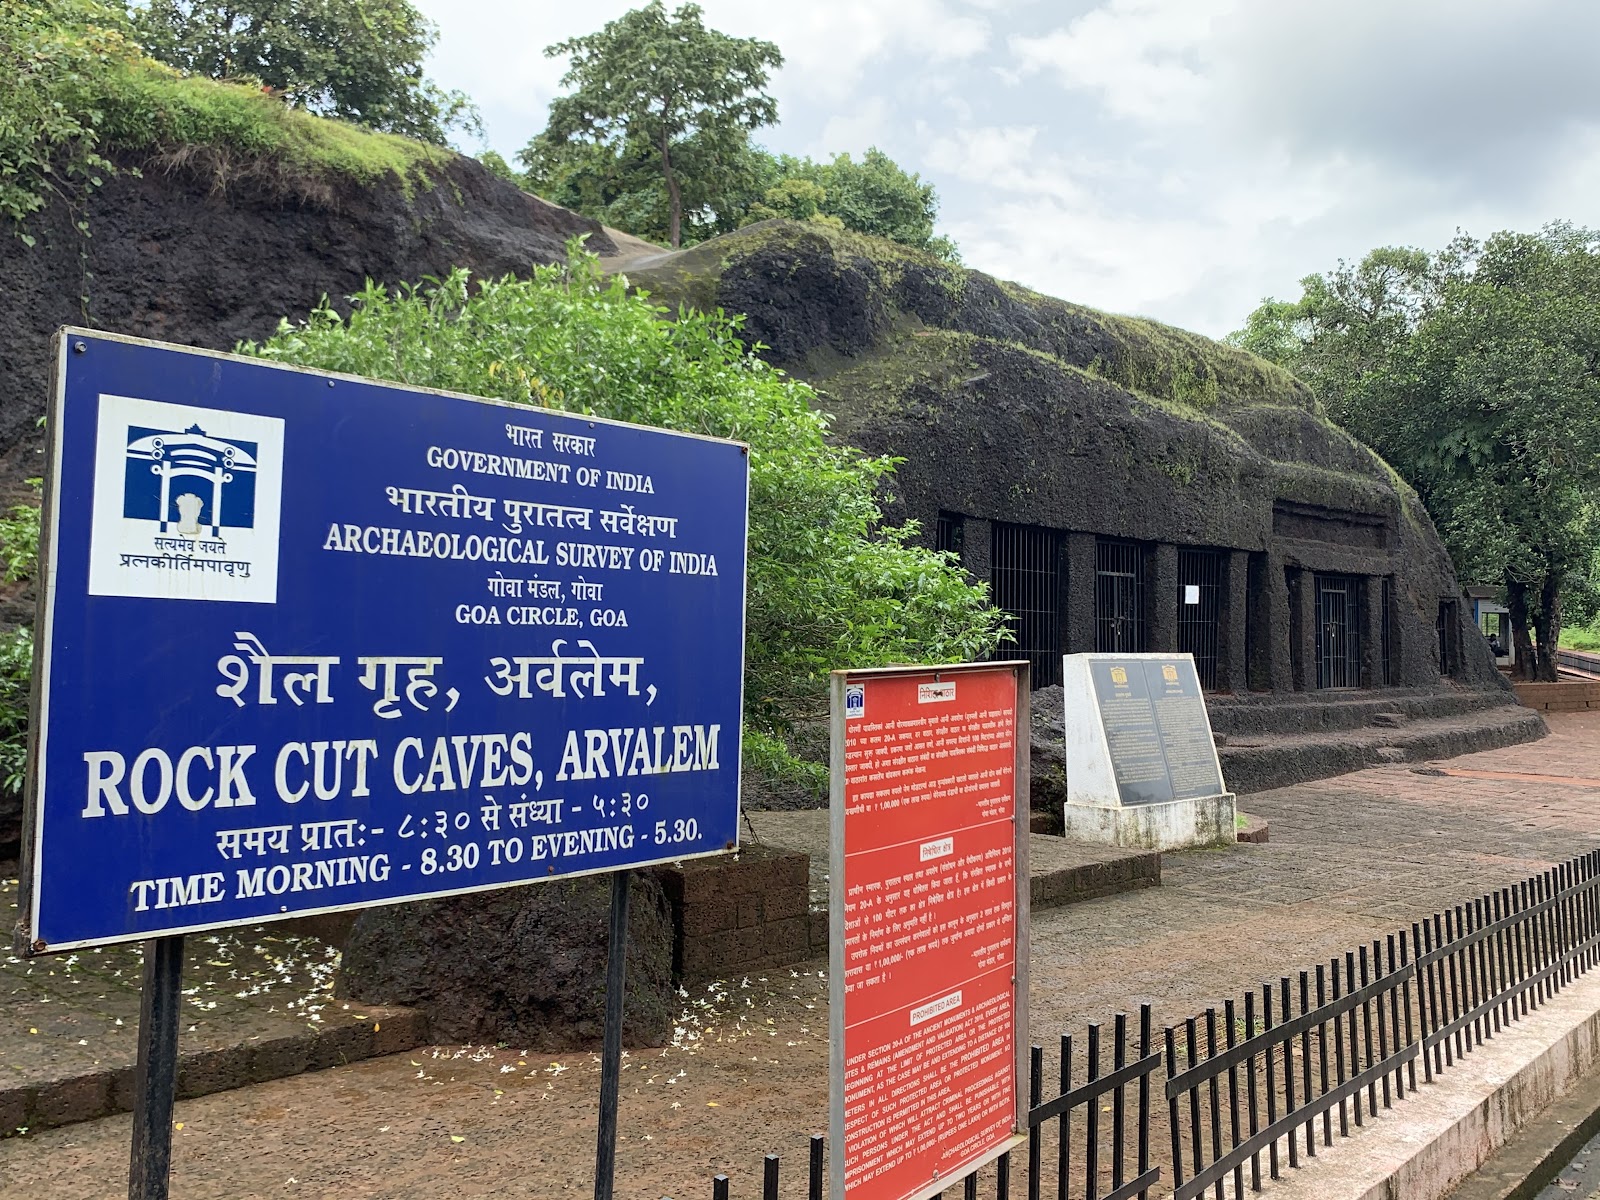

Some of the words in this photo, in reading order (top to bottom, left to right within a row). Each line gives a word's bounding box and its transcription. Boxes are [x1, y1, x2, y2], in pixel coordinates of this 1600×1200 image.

[505, 423, 543, 448] भारत
[553, 432, 596, 457] सरकार
[427, 447, 570, 484] GOVERNMENT
[576, 467, 601, 487] OF
[606, 471, 654, 494] INDIA
[385, 485, 495, 520] भारतीय
[503, 500, 592, 533] पुरातत्व
[600, 504, 677, 538] सर्वेक्षण
[154, 534, 195, 552] सत्यमेव
[199, 538, 226, 554] जयते
[323, 524, 548, 565] ARCHAEOLOGICAL
[556, 542, 633, 569] SURVEY
[640, 549, 664, 571] OF
[669, 552, 718, 576] INDIA
[488, 571, 522, 597] गोवा
[528, 574, 566, 603] मंडल,
[572, 575, 603, 601] गोवा
[456, 605, 500, 625] GOA
[507, 607, 583, 628] CIRCLE,
[590, 609, 628, 627] GOA
[215, 632, 340, 707] शैल
[358, 656, 460, 719] गृह,
[484, 640, 658, 706] अर्वलेम,
[82, 744, 257, 818] ROCK
[275, 740, 378, 804] CUT
[394, 732, 544, 794] CAVES,
[556, 724, 720, 782] ARVALEM
[216, 823, 290, 860] समय
[481, 796, 502, 829] से
[508, 793, 563, 827] संध्या
[131, 873, 226, 912] TIME
[235, 855, 389, 899] MORNING
[421, 845, 479, 875] 8.30
[488, 838, 523, 866] TO
[531, 825, 634, 860] EVENING
[654, 820, 703, 845] 5.30.
[873, 913, 882, 923] 100
[912, 1001, 945, 1022] PROHIBITED
[946, 995, 960, 1009] AREA
[847, 1053, 866, 1067] UNDER
[869, 1100, 874, 1108] IN
[872, 1110, 879, 1119] OF
[863, 1141, 888, 1159] PERSONS
[863, 1171, 874, 1183] MAY
